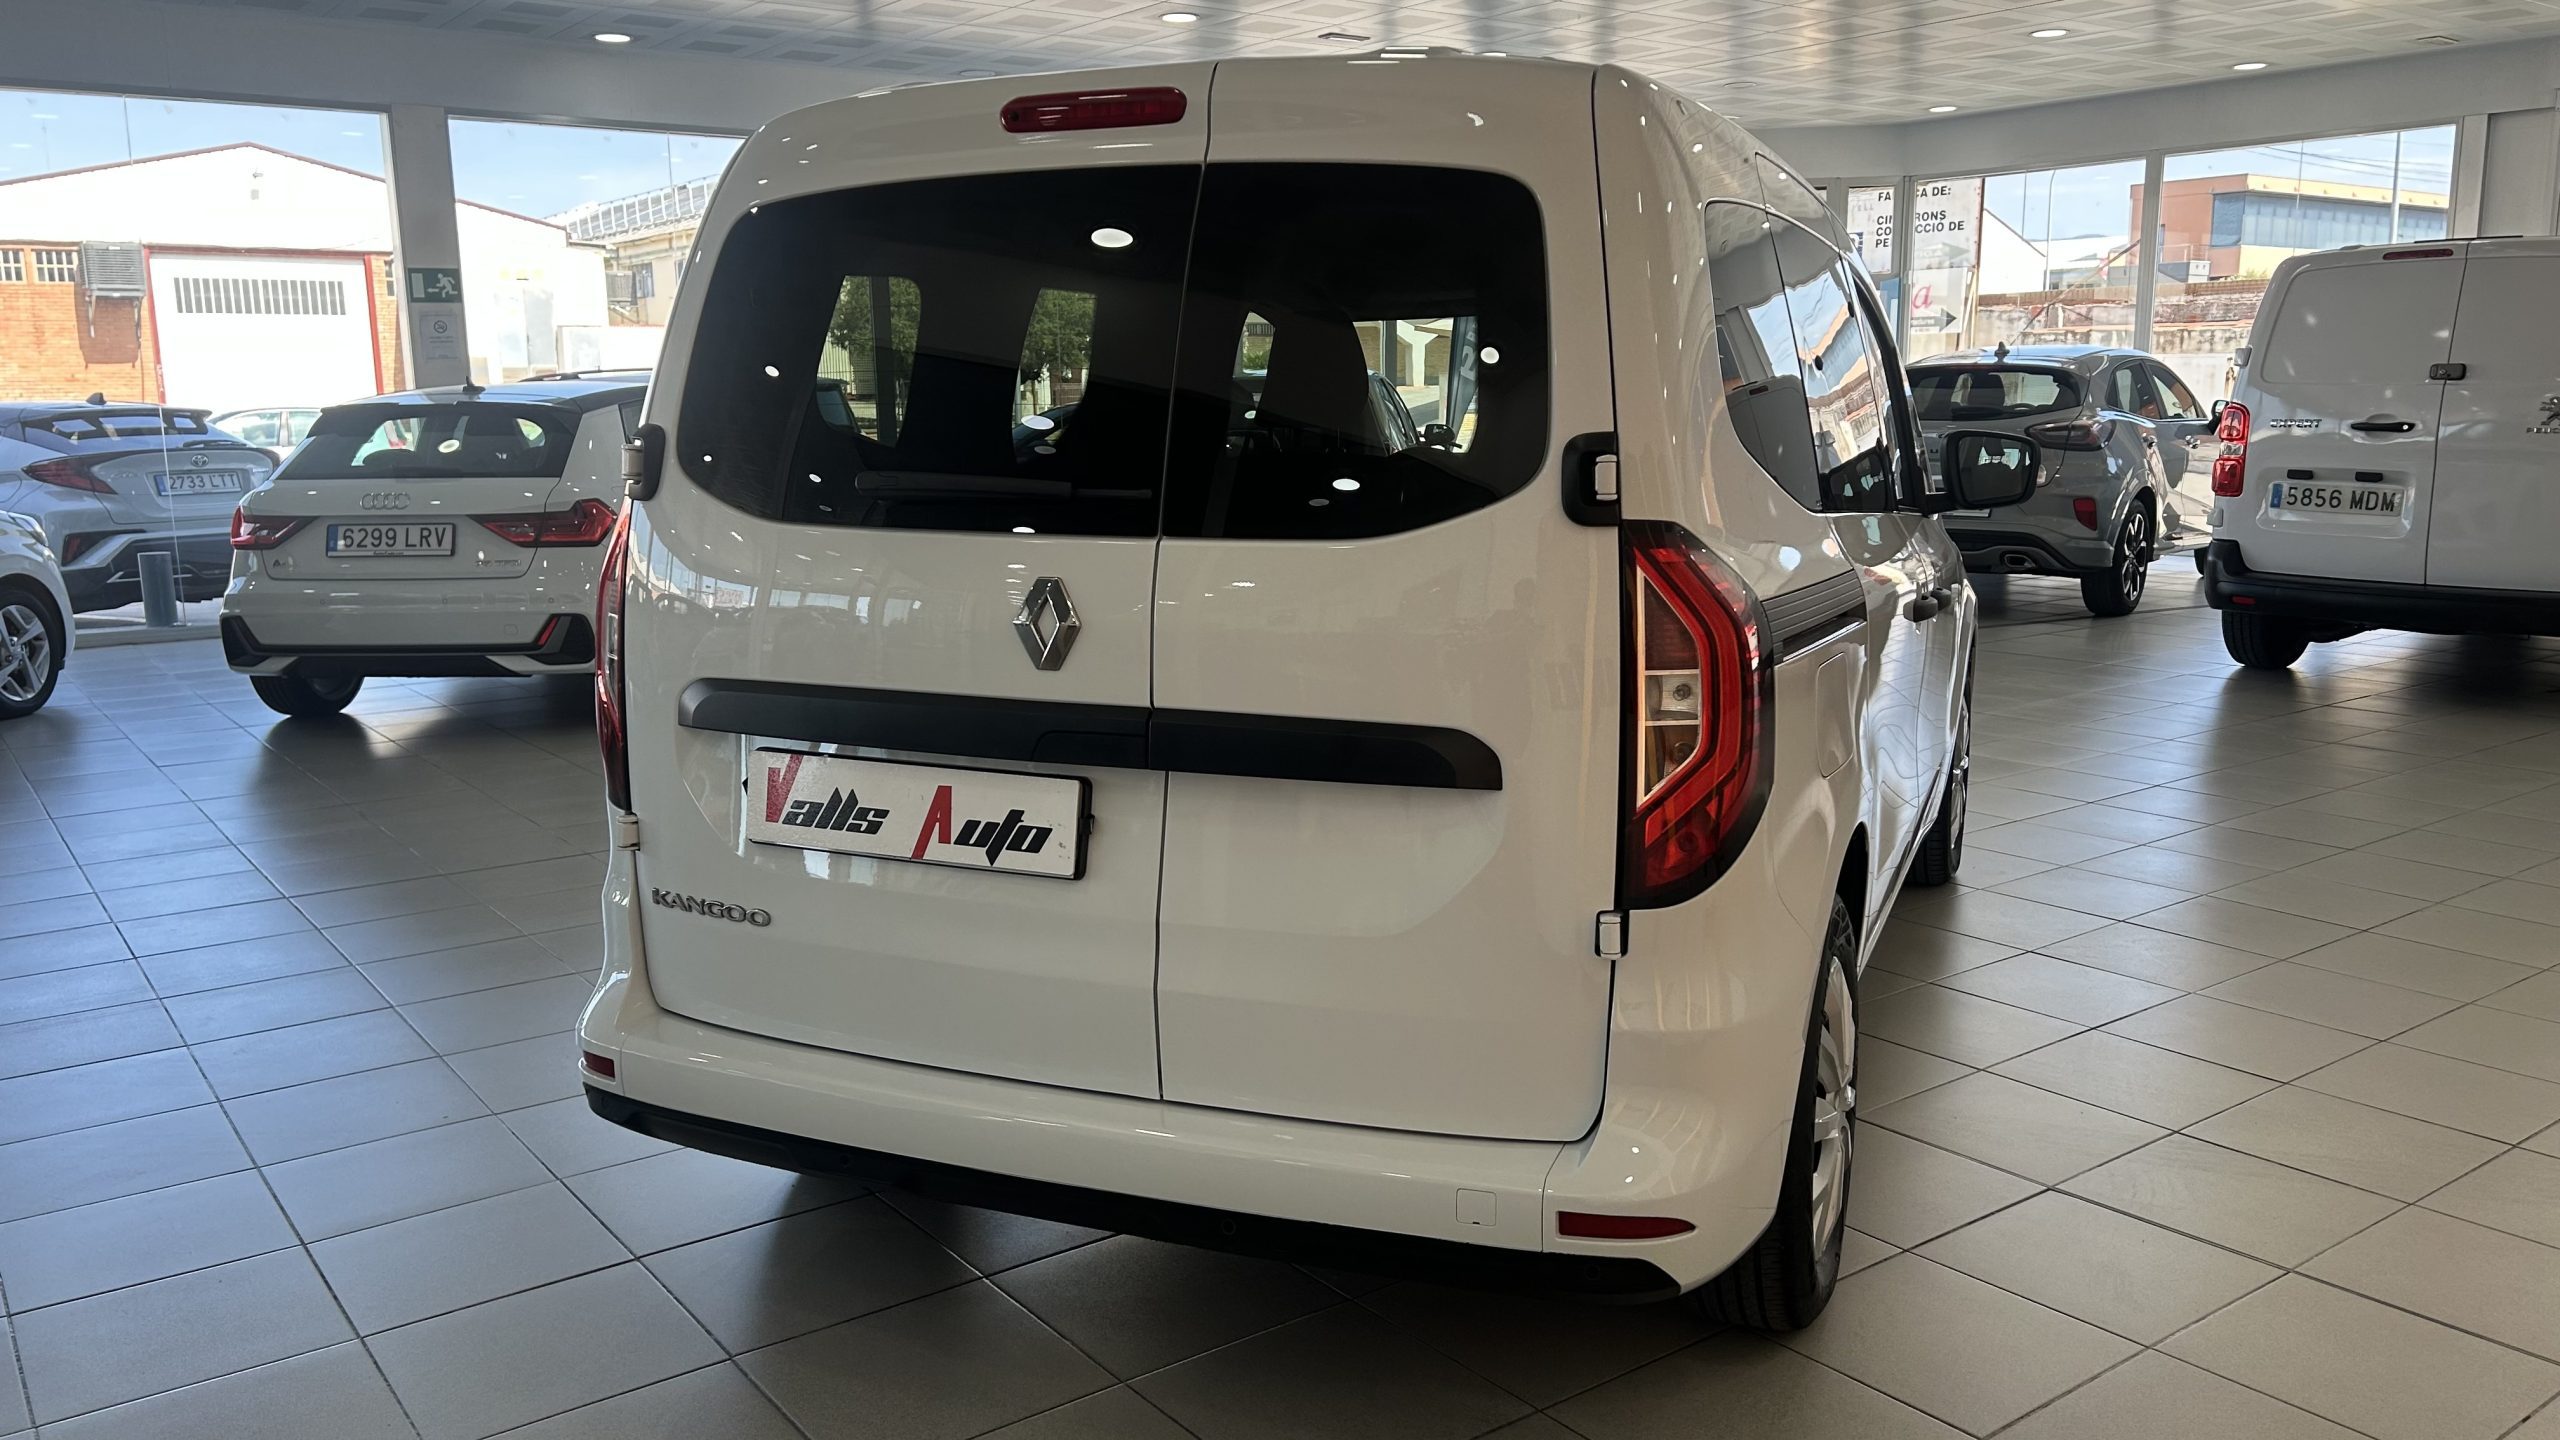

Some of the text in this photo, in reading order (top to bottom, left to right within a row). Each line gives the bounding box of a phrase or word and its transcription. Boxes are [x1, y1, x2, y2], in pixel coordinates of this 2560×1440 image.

[1932, 186, 1951, 197] DE:
[1949, 221, 1965, 231] DE
[2270, 418, 2322, 428] EXPERT
[169, 473, 237, 490] 2733 LTT
[2286, 486, 2397, 512] 5856 MDM
[343, 527, 447, 548] 6299 LRV
[765, 754, 1053, 867] Valls Auto
[652, 887, 771, 927] KANGOO
